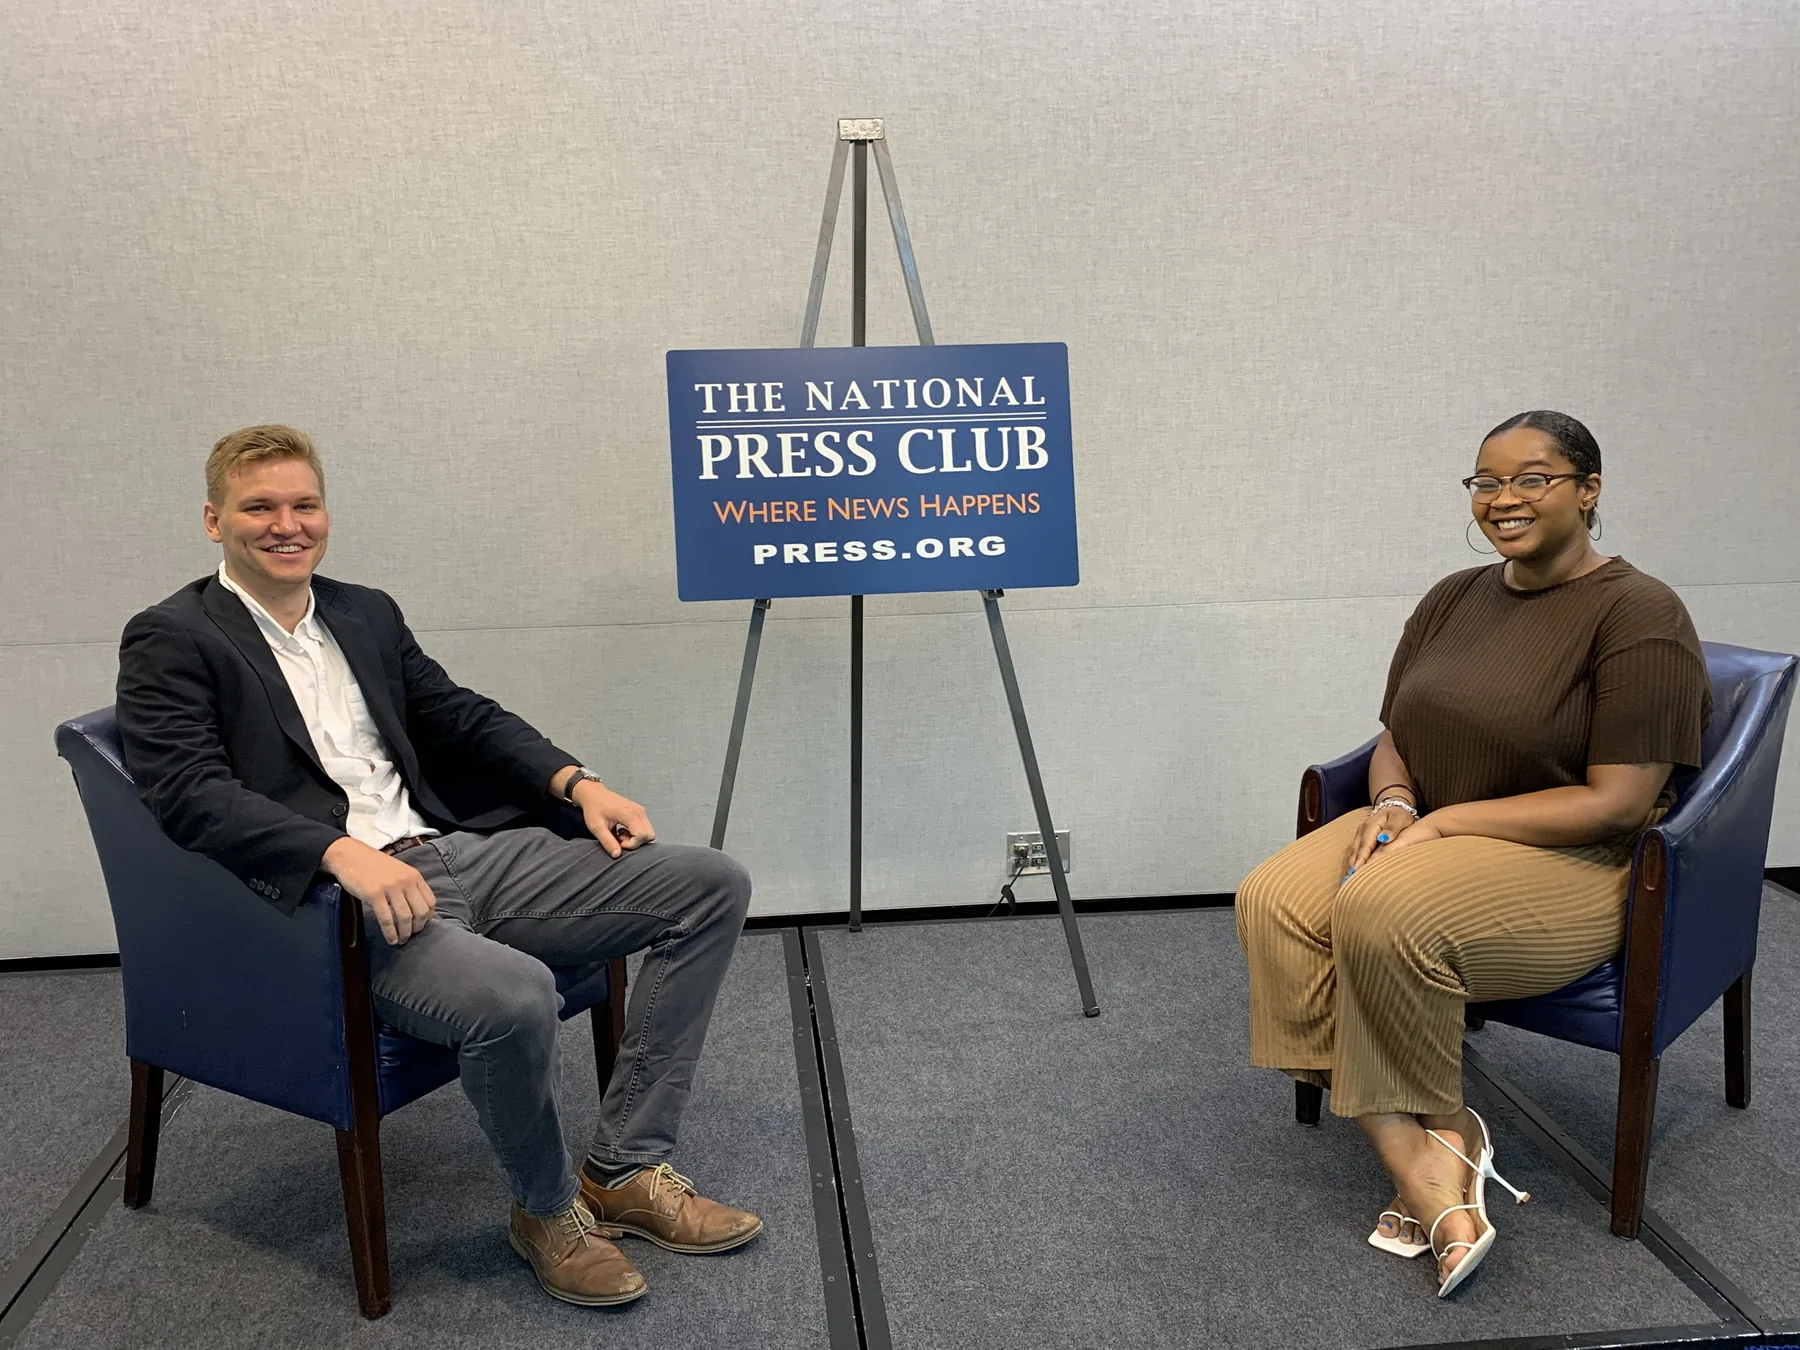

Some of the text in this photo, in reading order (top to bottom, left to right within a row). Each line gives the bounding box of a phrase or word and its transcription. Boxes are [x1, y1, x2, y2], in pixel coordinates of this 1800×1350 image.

[694, 375, 1046, 414] THE NATIONAL
[696, 425, 1049, 480] PRESS CLUB
[753, 535, 1007, 565] PRESS.ORG
